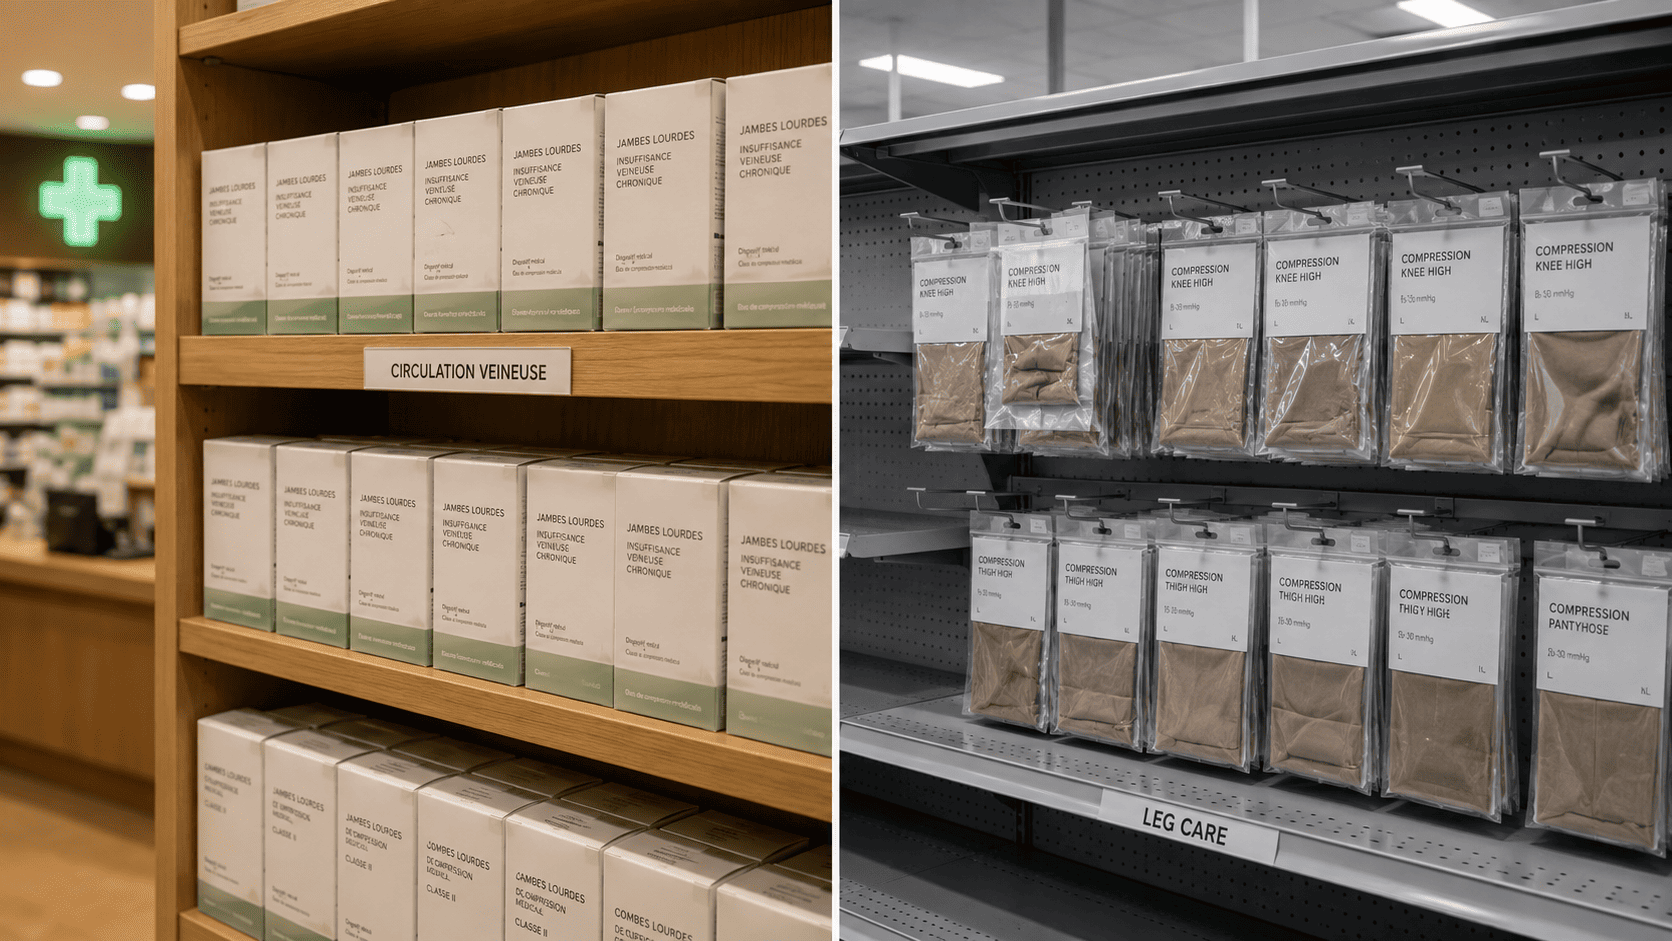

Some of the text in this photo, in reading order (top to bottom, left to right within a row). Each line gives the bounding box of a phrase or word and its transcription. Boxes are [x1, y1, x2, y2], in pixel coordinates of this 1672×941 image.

[740, 116, 828, 135] JAMBES LOURDES
[617, 130, 695, 149] JAMBES LOURDES
[739, 139, 802, 154] INSUFFISANCE
[513, 144, 581, 160] JAMBES LOURDES
[616, 152, 672, 166] INSUFFISANCE
[425, 154, 486, 169] JAMBES LOURDES
[740, 154, 782, 166] VEINEUSE
[348, 164, 403, 179] JAMBES LOURDES
[513, 163, 562, 176] INSUFFISANCE
[616, 165, 654, 177] VEINEUSE
[739, 165, 791, 179] CHRONIQUE
[276, 174, 326, 187] JAMBES LOURDES
[513, 175, 547, 186] VEINEUSE
[616, 176, 662, 189] CHRONIQUE
[513, 186, 555, 197] CHRONIQUE
[425, 195, 461, 206] CHRONIQUE
[1535, 242, 1614, 256] COMPRESSION
[1275, 256, 1339, 270] COMPRESSION
[1401, 250, 1471, 264] COMPRESSION
[1008, 264, 1060, 277] COMPRESSION
[1171, 264, 1230, 276] COMPRESSION
[1535, 258, 1592, 271] KNEE HIGH
[1275, 271, 1322, 283] KNEE HIGH
[1401, 266, 1452, 278] KNEE HIGH
[920, 276, 967, 287] COMPRESSION
[1008, 277, 1045, 289] KNEE HIGH
[1171, 278, 1213, 289] KNEE HIGH
[920, 288, 954, 298] KNEE HIGH
[1534, 313, 1539, 321] L
[391, 363, 547, 380] CIRCULATION VEINEUSE
[284, 485, 336, 499] JAMBES LOURDES
[360, 494, 416, 508] JAMBES LOURDES
[442, 503, 505, 518] JAMBES LOURDES
[536, 513, 605, 529] JAMBES LOURDES
[627, 523, 703, 541] JAMBES LOURDES
[536, 541, 570, 552] VEINEUSE
[627, 542, 680, 556] INSUFFISANCE
[741, 535, 826, 554] JAMBES LOURDES
[536, 552, 577, 565] CHRONIQUE
[627, 553, 663, 565] VEINEUSE
[741, 554, 801, 570] INSUFFISANCE
[978, 555, 1025, 568] COMPRESSION
[626, 565, 672, 579] CHRONIQUE
[741, 567, 781, 580] VEINEUSE
[978, 567, 1013, 578] THIGH HIGH
[1065, 563, 1117, 576] COMPRESSION
[1165, 569, 1223, 582] COMPRESSION
[740, 579, 791, 595] CHRONIQUE
[1065, 576, 1103, 588] THIGH HIGH
[1165, 582, 1208, 594] THIGH HIGH
[1279, 577, 1342, 593] COMPRESSION
[1279, 591, 1325, 605] THIGH HIGH
[1399, 588, 1469, 605] COMPRESSION
[1549, 602, 1630, 621] COMPRESSION
[1549, 618, 1609, 636] PANTYHOSE
[1547, 671, 1553, 679] L
[297, 796, 325, 813] LOURDES
[346, 813, 402, 840] JAMBES LOURDES
[1142, 807, 1228, 846] LEG CARE
[345, 855, 367, 869] CLASSE
[457, 853, 490, 871] LOURDES
[426, 884, 456, 902] CLASSE II
[548, 884, 585, 904] LOURDES
[515, 917, 548, 937] CLASSE II
[614, 907, 693, 941] COMBES LOURDES
